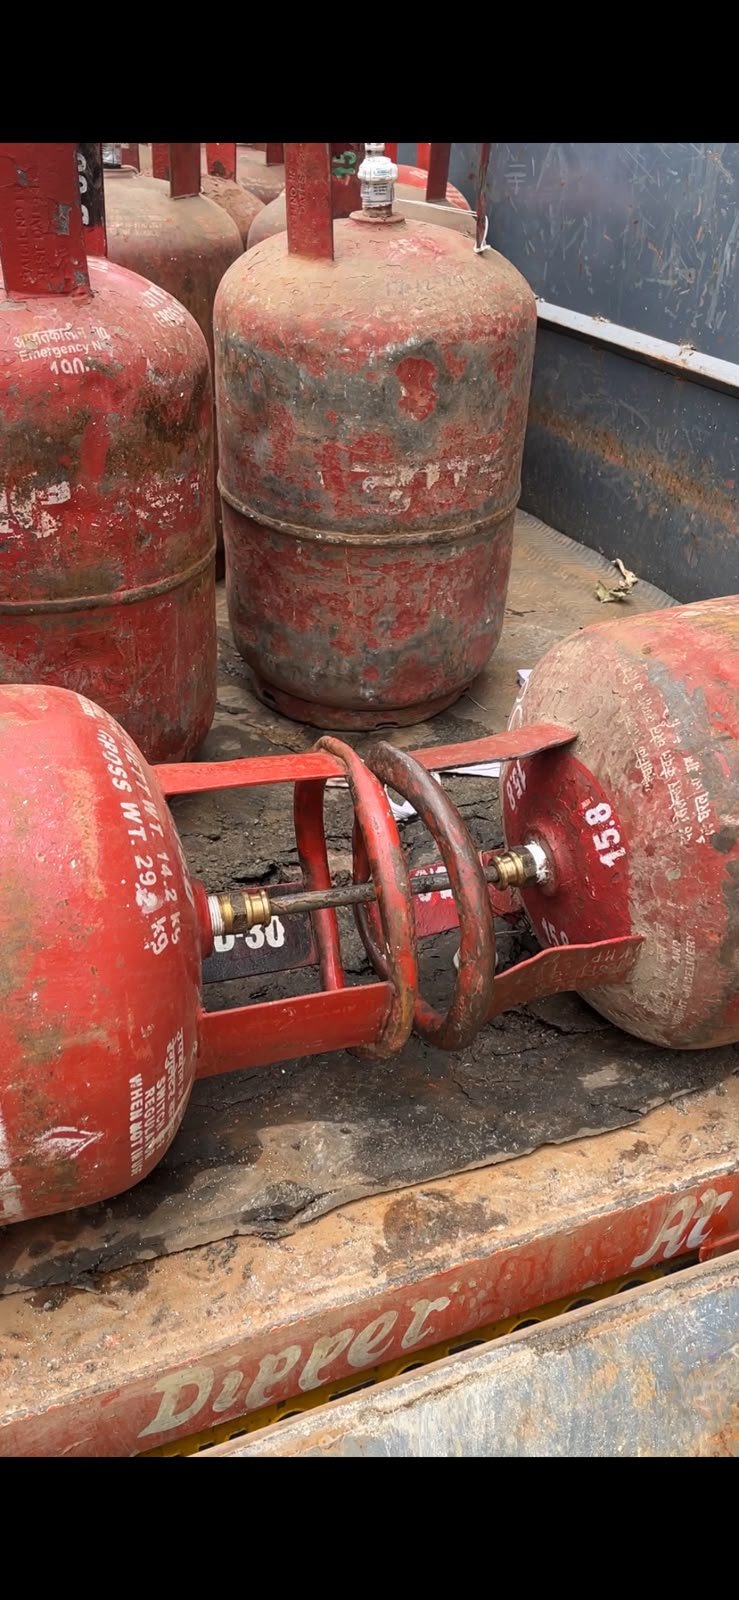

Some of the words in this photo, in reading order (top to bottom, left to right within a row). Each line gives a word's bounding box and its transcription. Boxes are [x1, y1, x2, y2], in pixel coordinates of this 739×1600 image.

[19, 343, 90, 362] Emergency
[97, 729, 133, 793] GROSS
[120, 802, 147, 846] WT.
[150, 916, 168, 955] kg
[584, 802, 626, 868] 15.8
[157, 852, 178, 902] 14.2
[671, 940, 682, 963] AND
[684, 931, 696, 984] DELIVERY
[128, 1073, 143, 1122] WHEN
[156, 1076, 166, 1131] SWITCH
[137, 1295, 450, 1438] Dipper
